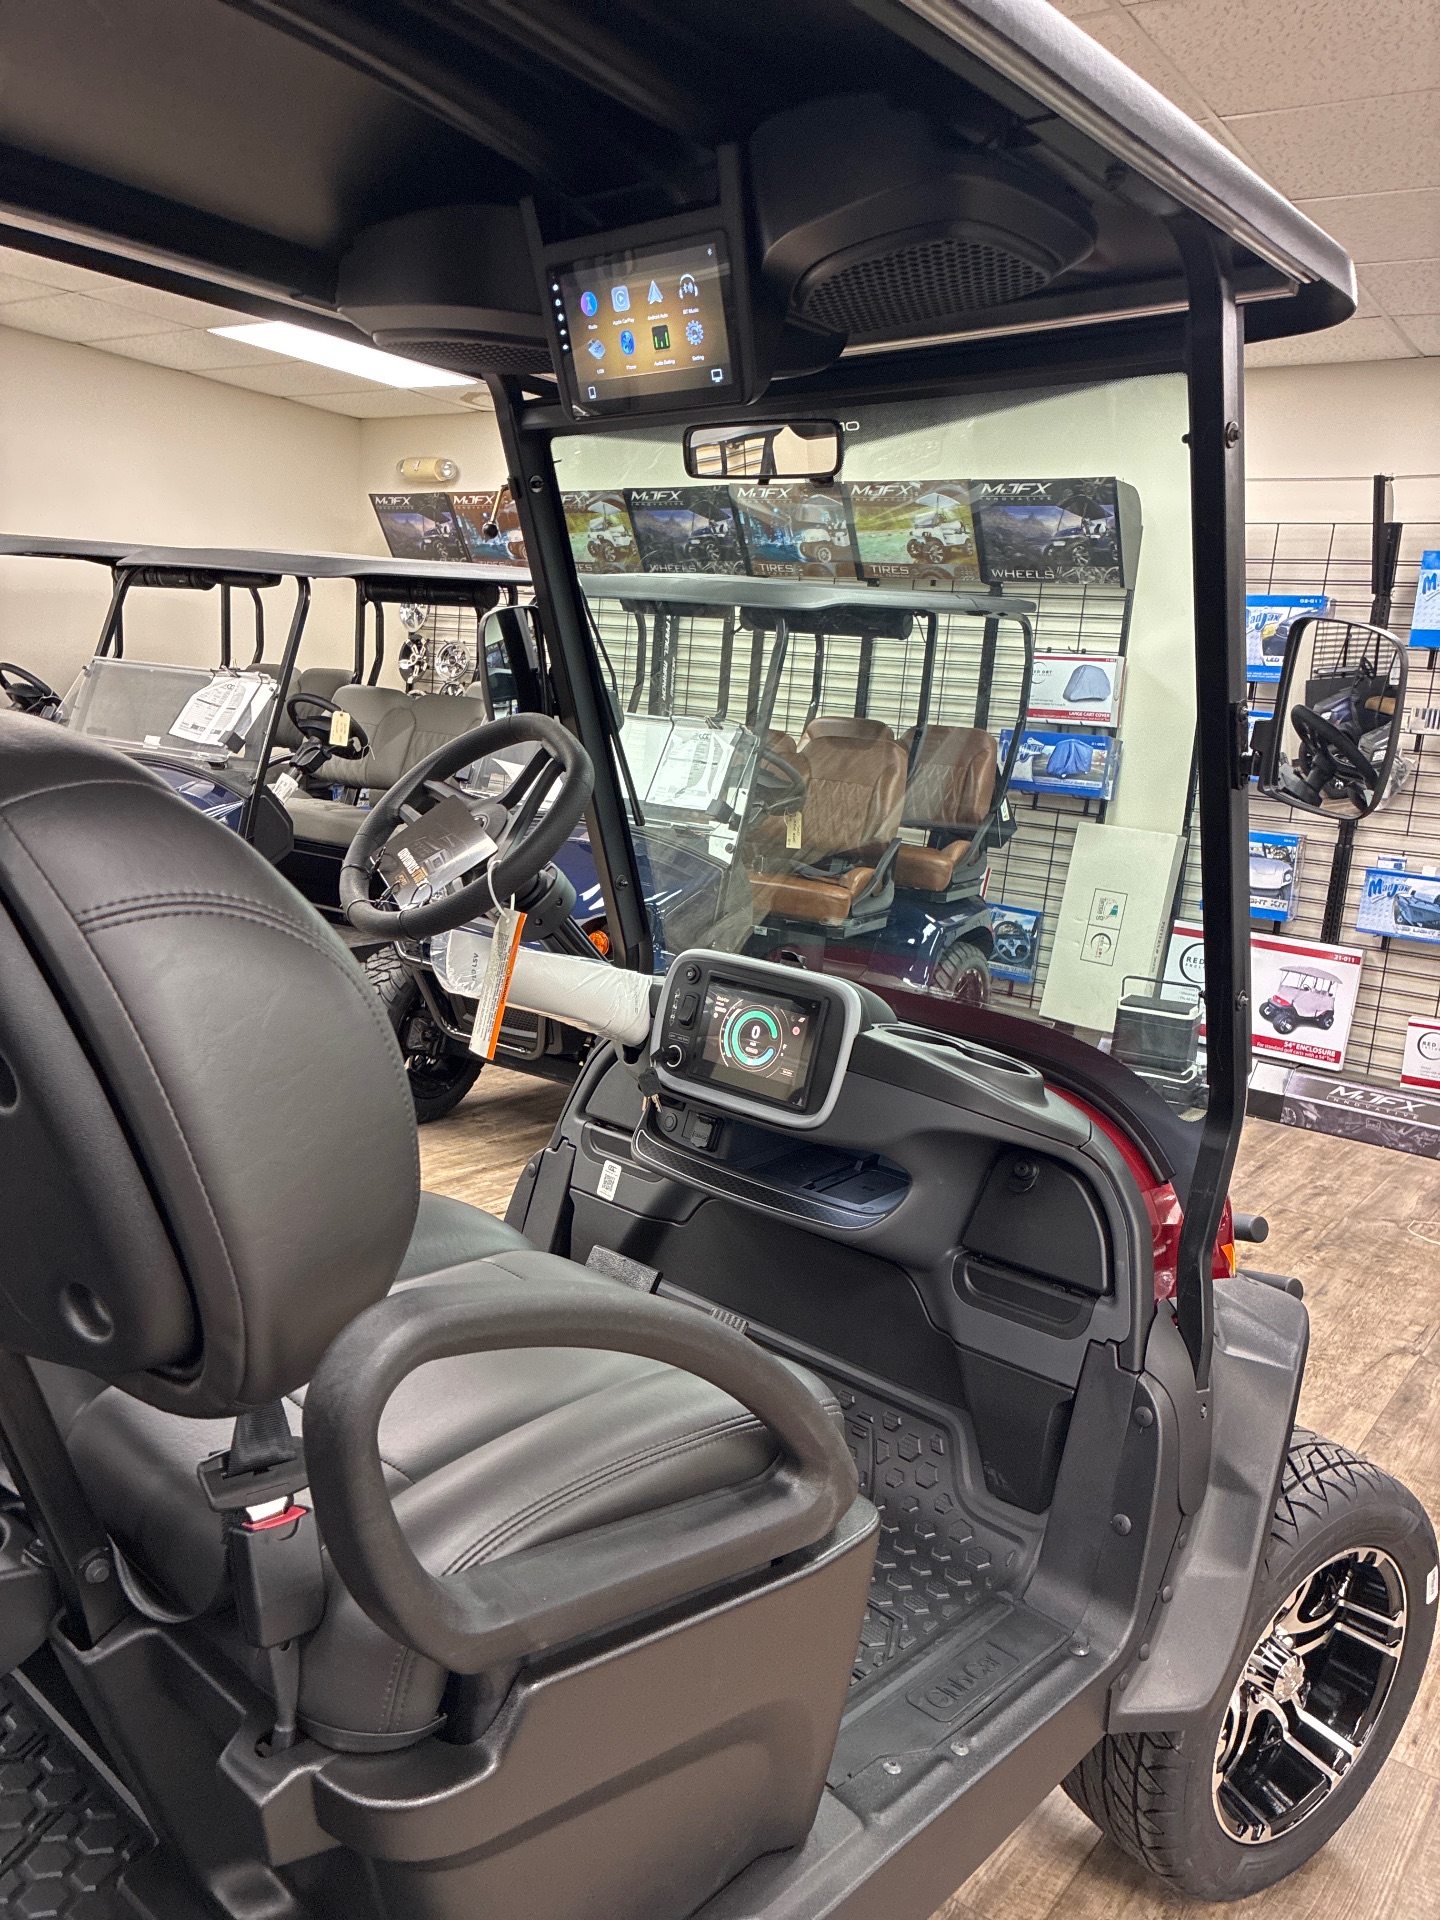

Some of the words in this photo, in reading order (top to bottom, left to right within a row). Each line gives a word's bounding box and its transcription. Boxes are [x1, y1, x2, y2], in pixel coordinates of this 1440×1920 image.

[649, 563, 697, 573] WHEELS
[758, 563, 795, 573] TIRES
[870, 564, 910, 575] TIRES
[991, 568, 1055, 580] WHEELS
[1333, 954, 1355, 963] 21-011
[751, 1025, 761, 1039] 0
[1296, 1043, 1336, 1056] ENCLOSURE
[1326, 1095, 1420, 1120] INNOVATIVE
